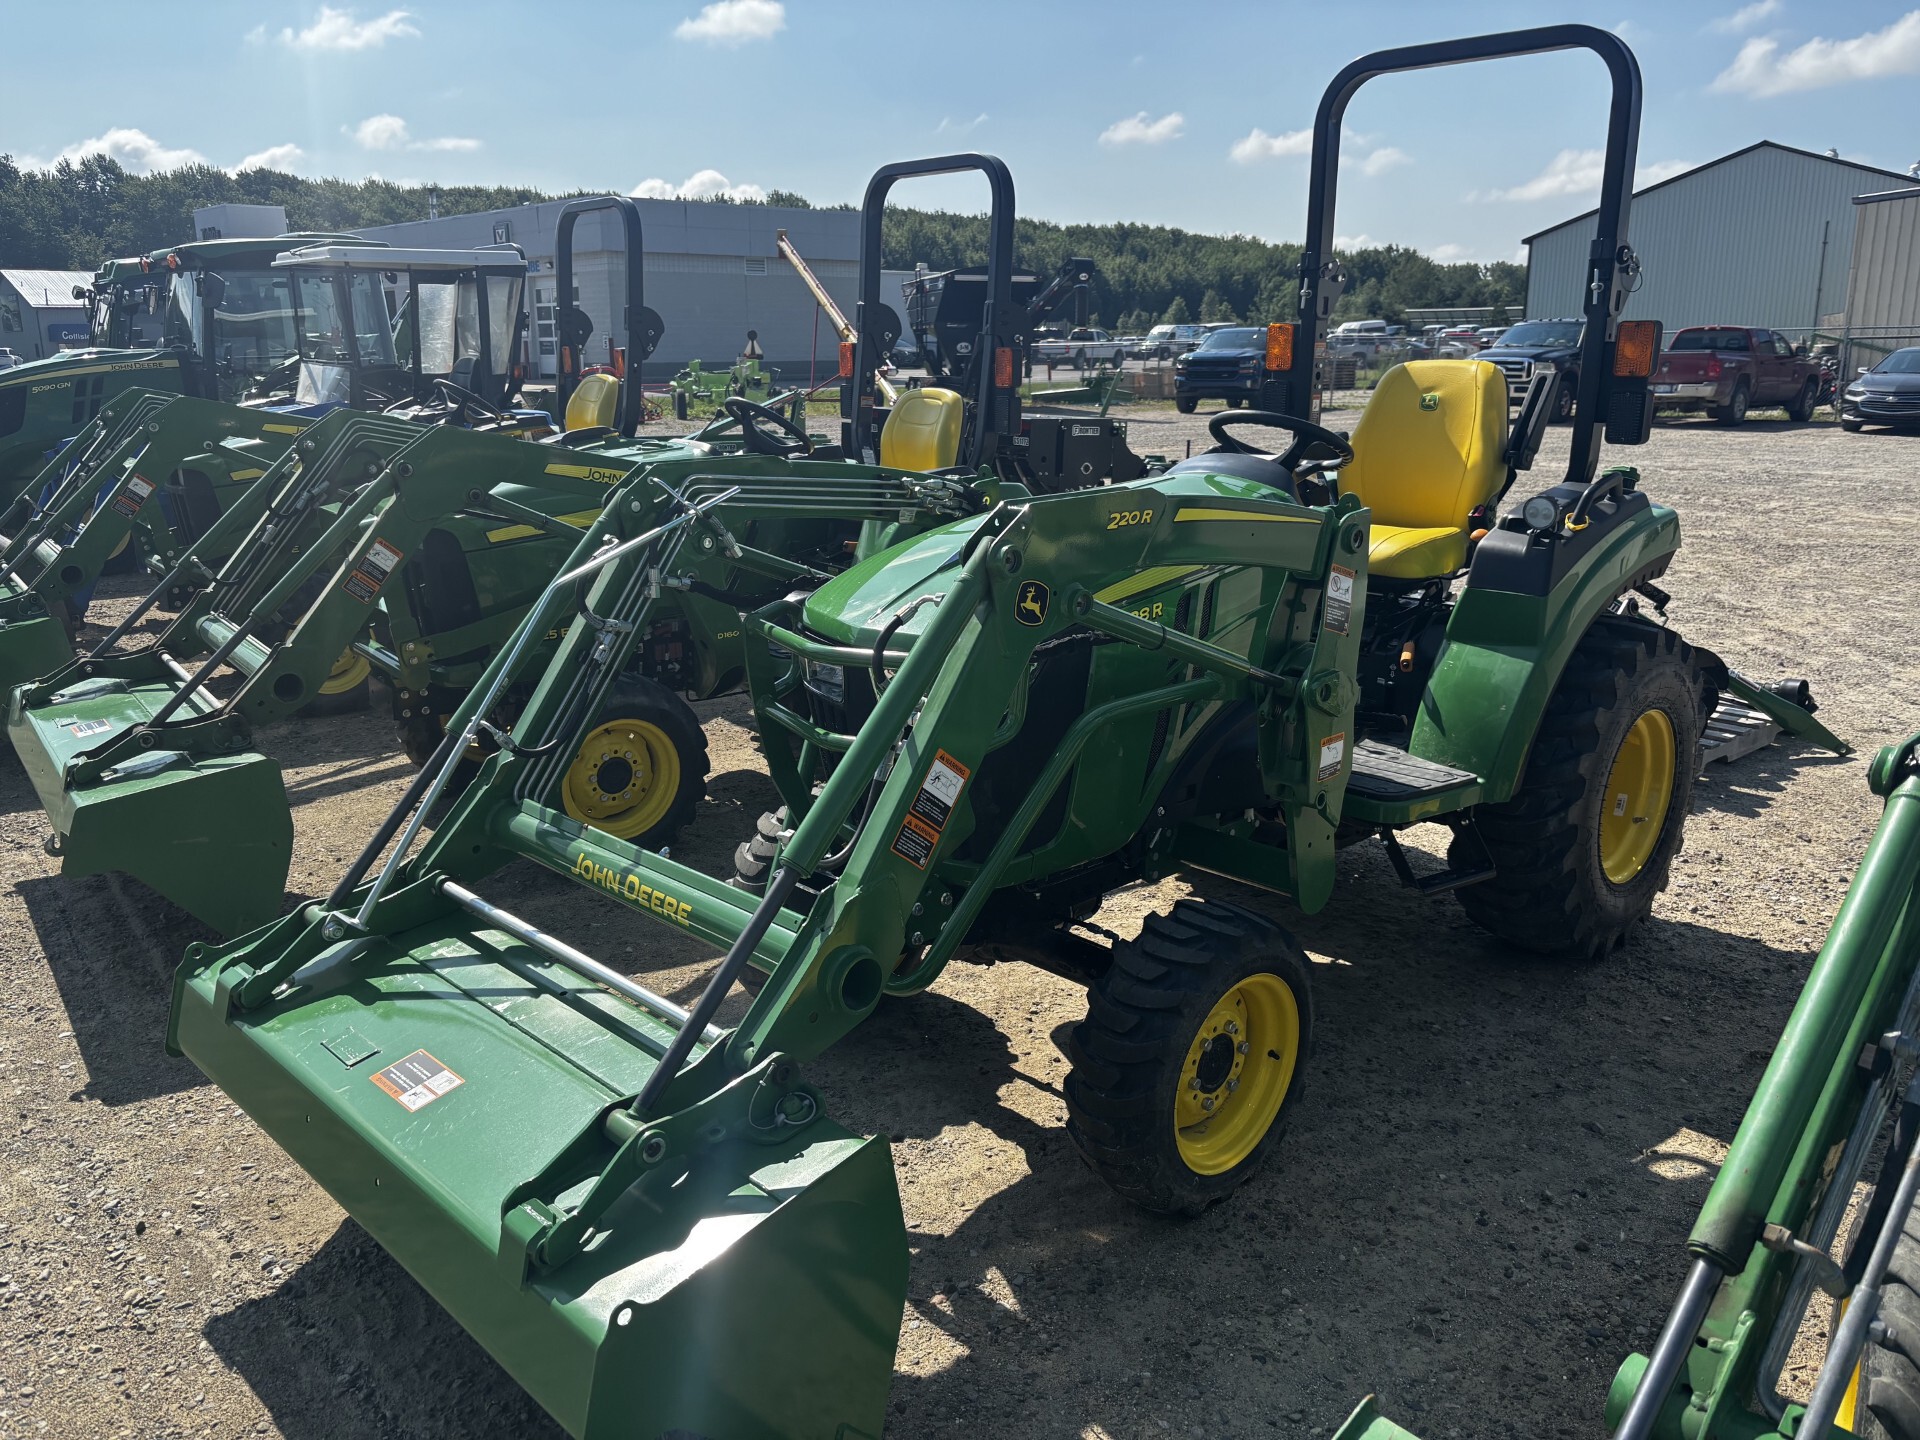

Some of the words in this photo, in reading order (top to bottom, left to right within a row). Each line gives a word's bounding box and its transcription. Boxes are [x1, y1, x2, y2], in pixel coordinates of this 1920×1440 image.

[111, 363, 135, 371] JOHN
[134, 361, 164, 370] DEERE
[32, 383, 56, 394] 5090
[57, 381, 71, 390] GN
[583, 467, 622, 483] JOHN
[1107, 511, 1140, 530] 220
[1141, 509, 1154, 524] R
[1153, 602, 1163, 618] R
[717, 630, 740, 640] D160
[945, 757, 966, 776] WARNING
[913, 822, 935, 840] WARNING
[570, 852, 621, 894] JOHN
[624, 874, 693, 927] DEERE
